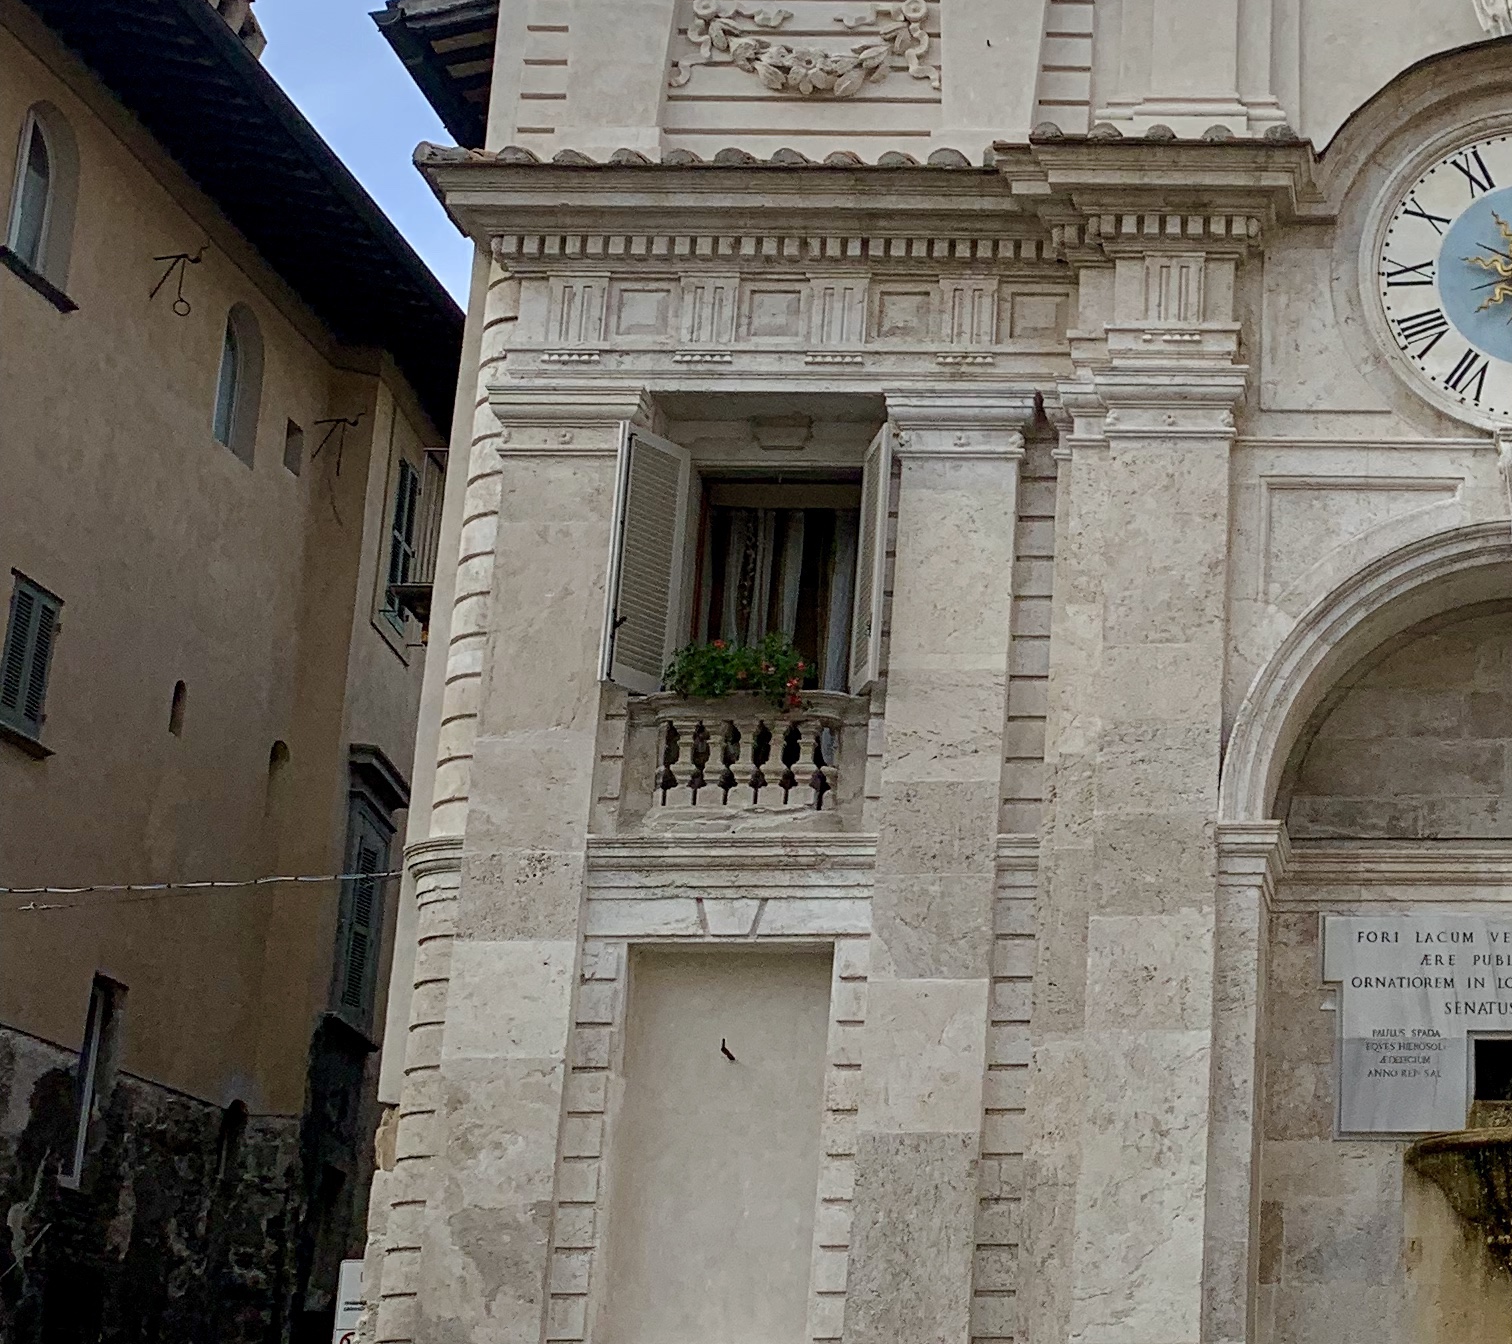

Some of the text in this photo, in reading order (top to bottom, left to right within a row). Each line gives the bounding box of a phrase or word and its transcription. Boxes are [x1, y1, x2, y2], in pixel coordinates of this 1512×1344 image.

[1450, 149, 1496, 198] XI
[1357, 931, 1400, 944] FORI
[1415, 931, 1475, 944] LACUM
[1351, 976, 1455, 990] ORNATIOREM
[1467, 976, 1486, 990] IN
